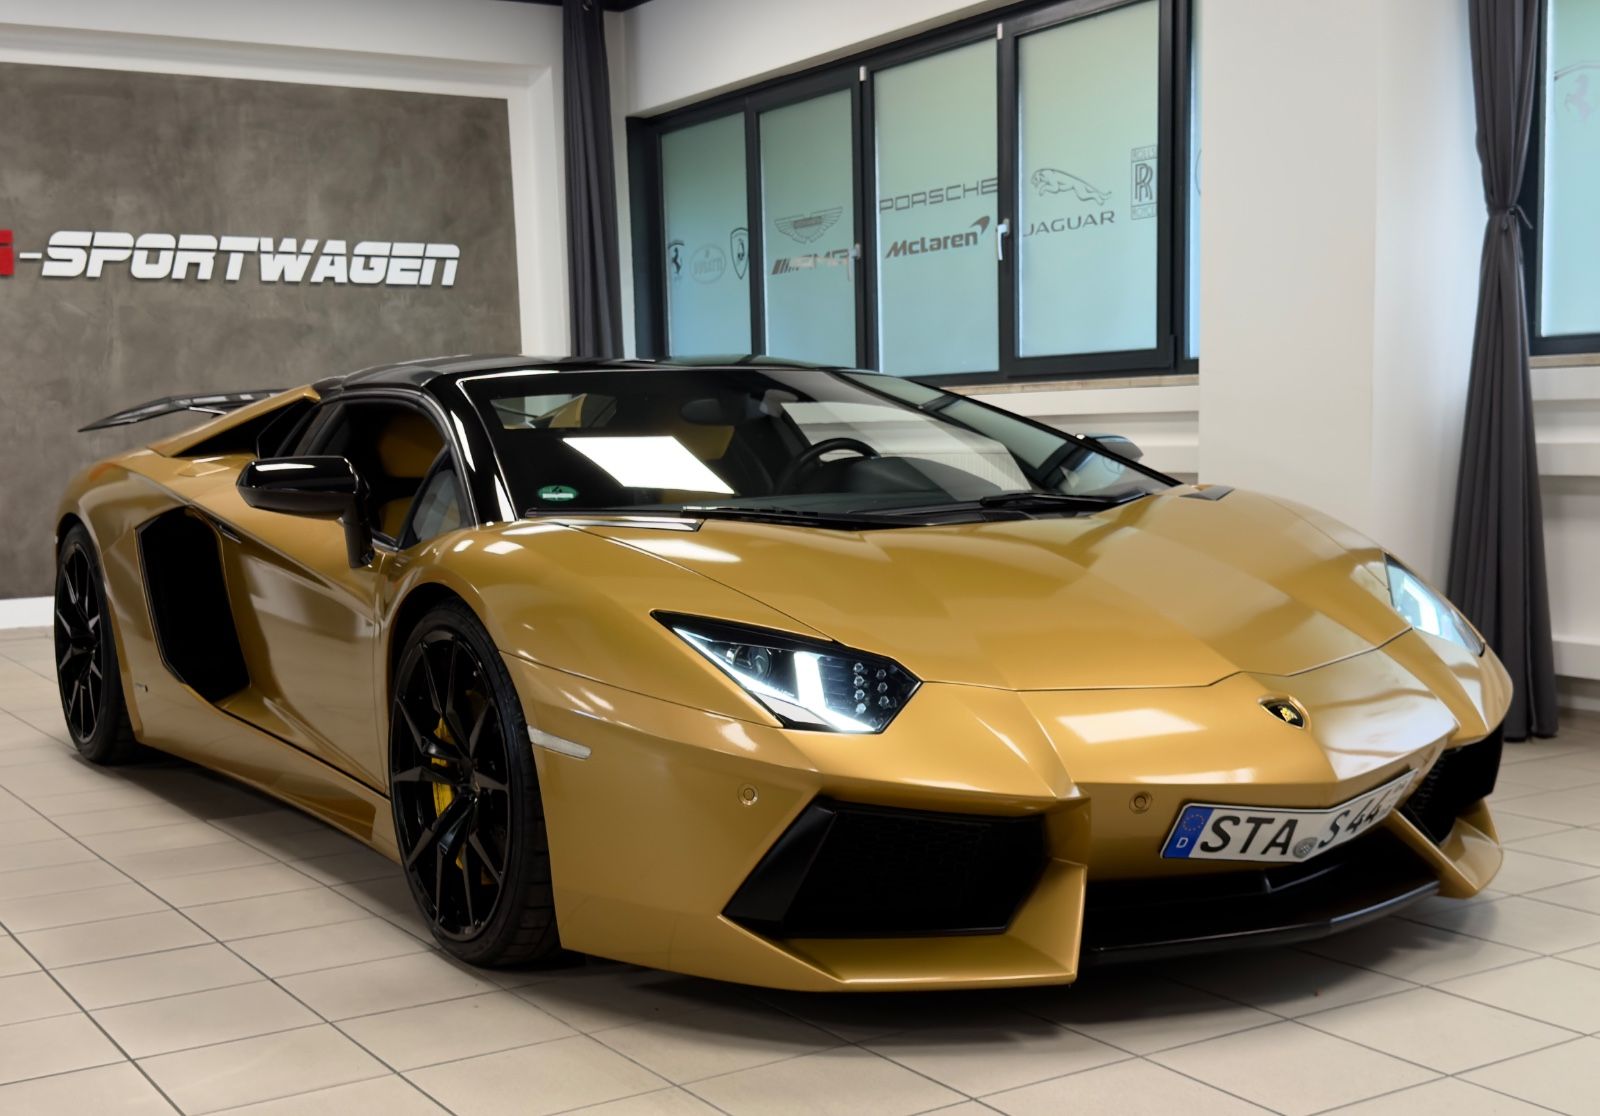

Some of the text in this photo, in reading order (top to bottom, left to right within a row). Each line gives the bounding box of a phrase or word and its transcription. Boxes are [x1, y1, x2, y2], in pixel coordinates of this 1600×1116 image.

[879, 177, 999, 213] PORSCHE
[1023, 210, 1115, 238] JAGUAR
[0, 229, 460, 286] -SPORTWAGEN
[886, 230, 979, 259] McLaren
[1175, 836, 1189, 848] D
[1200, 815, 1299, 856] STA
